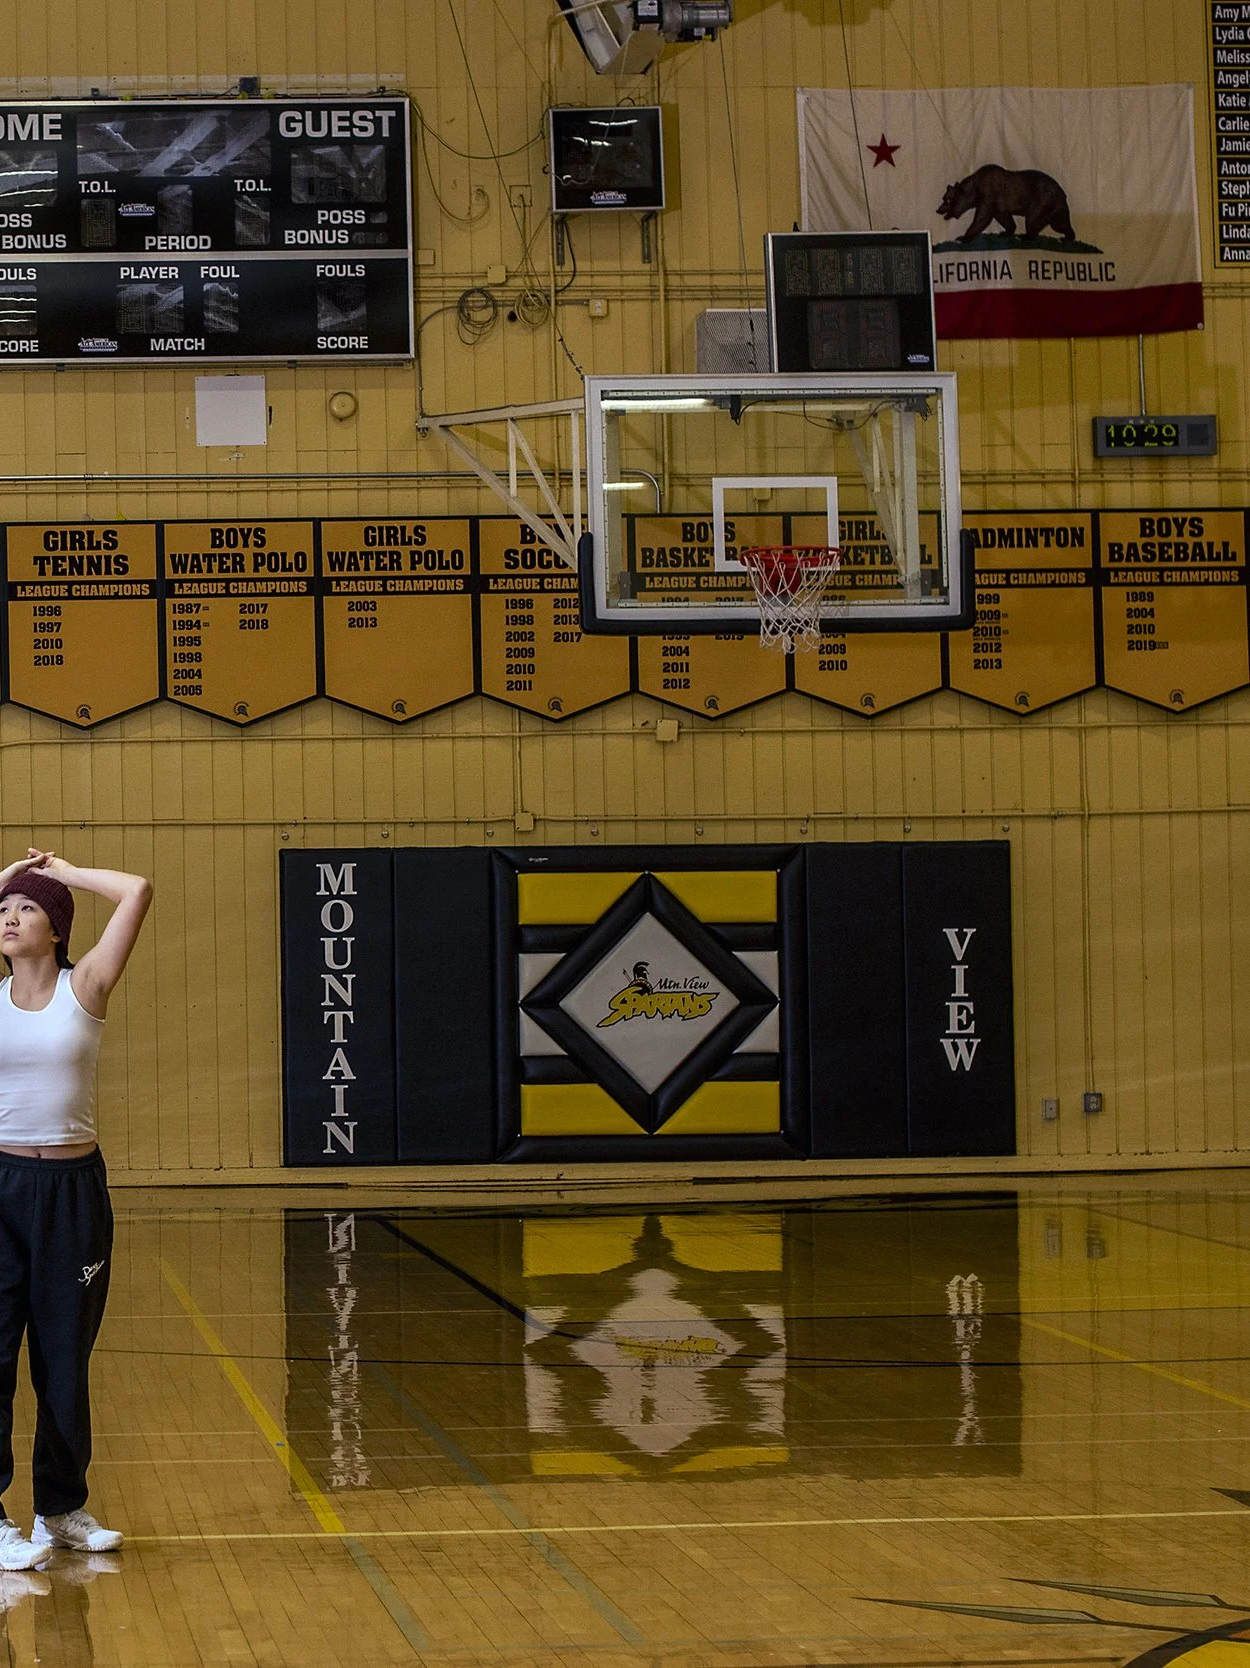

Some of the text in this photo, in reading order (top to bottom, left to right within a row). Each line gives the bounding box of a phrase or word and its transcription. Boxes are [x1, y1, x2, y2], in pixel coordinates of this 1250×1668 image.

[1215, 5, 1239, 22] Amy
[1215, 27, 1244, 44] Lydia
[1217, 49, 1250, 64] Meliss
[1217, 70, 1250, 88] Angel
[1218, 93, 1246, 107] Katie
[279, 110, 396, 138] GUEST
[1218, 116, 1250, 131] Carlie
[1220, 137, 1250, 152] Jamie
[79, 181, 116, 193] T.O.L.
[235, 180, 272, 191] T.O.L.
[318, 210, 365, 224] POSS
[1222, 203, 1236, 217] Fu
[284, 230, 349, 244] BONUS
[1222, 224, 1250, 239] Linda
[2, 234, 67, 249] BONUS
[145, 235, 211, 250] PERIOD
[120, 267, 179, 279] PLAYER
[201, 266, 239, 278] FOUL
[316, 265, 365, 277] FOULS
[933, 260, 1115, 283] IFORNIA REPUBLIC
[150, 339, 205, 351] MATCH
[317, 336, 368, 349] SCORE
[1139, 517, 1204, 538] BOYS
[43, 530, 118, 552] GIRLS
[210, 527, 266, 549] BOYS
[363, 525, 427, 547] GIRLS
[1108, 542, 1237, 563] BASEBALL
[33, 555, 129, 577] TENNIS
[170, 552, 307, 575] WATER POLO
[327, 550, 464, 573] WATER POLO
[489, 578, 540, 590] LEAGUE
[645, 577, 696, 589] LEAGUE
[1010, 572, 1086, 584] CHAMPIONS
[1110, 570, 1239, 584] LEAGUE CHAMPIONS
[16, 584, 150, 598] LEAGUE CHAMPIONS
[174, 581, 307, 595] LEAGUE CHAMPIONS
[332, 579, 464, 592] LEAGUE CHAMPIONS
[1126, 591, 1154, 602] 1989
[33, 605, 62, 617] 1996
[239, 603, 269, 614] 2017
[505, 599, 533, 609] 1996
[1126, 608, 1155, 619] 2004
[239, 619, 269, 630] 2018
[348, 617, 378, 628] 2013
[553, 632, 582, 642] 2017
[33, 655, 64, 666] 2018
[819, 660, 847, 671] 2010
[973, 659, 1002, 670] 2013
[663, 679, 690, 689] 2012
[653, 976, 710, 990] Mtn. View
[939, 928, 981, 1071] VIEW
[316, 863, 358, 1154] MOUNTAIN
